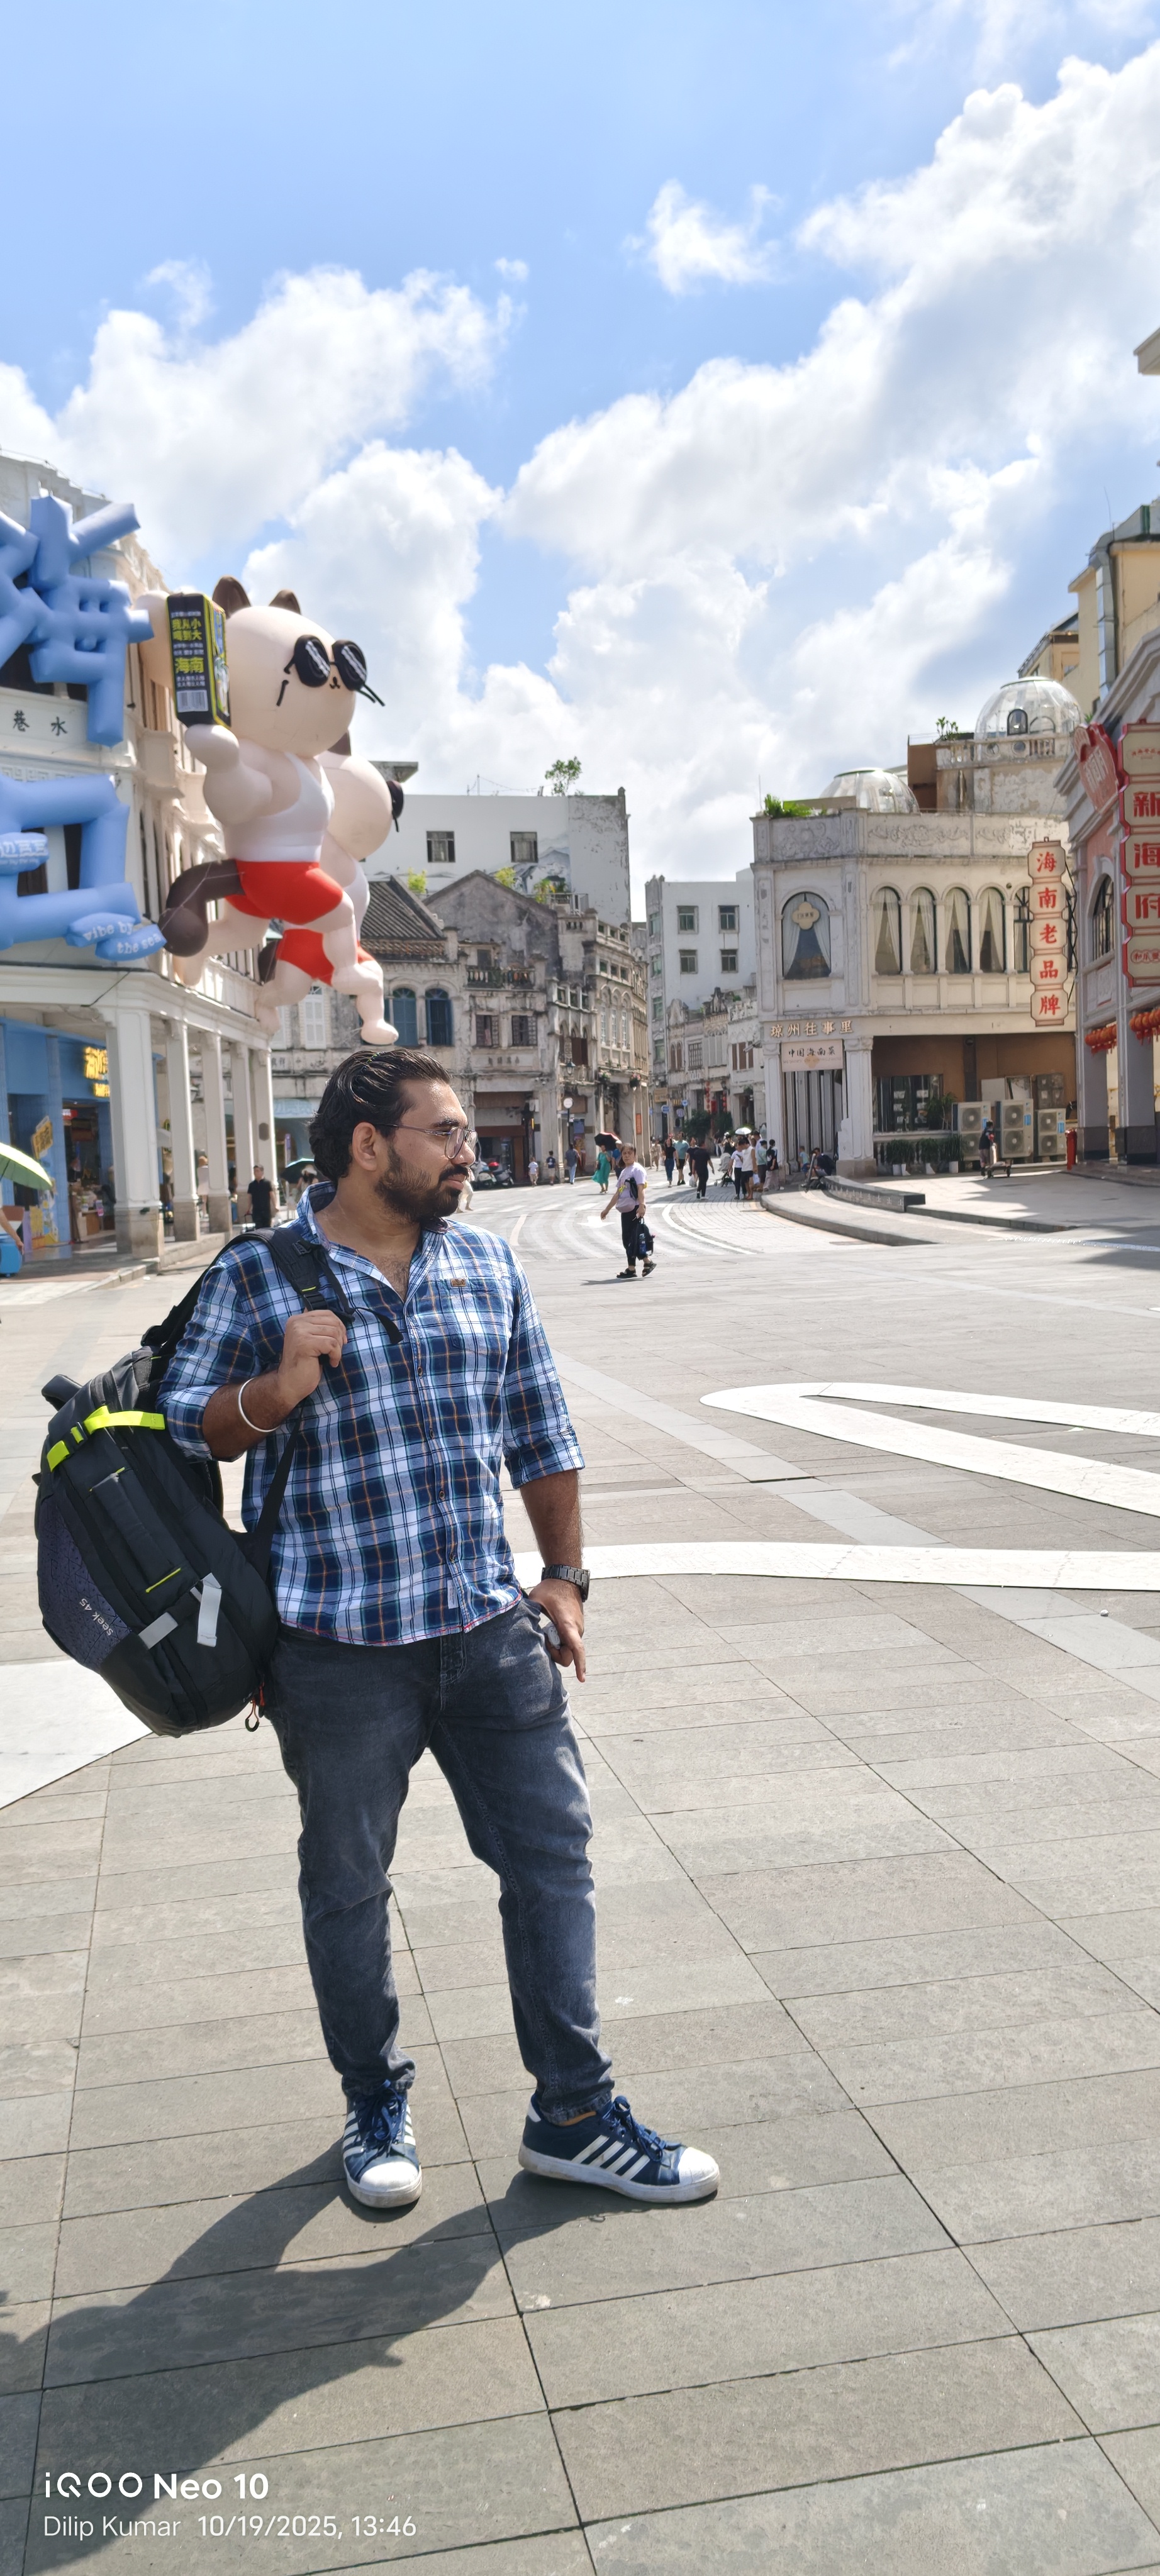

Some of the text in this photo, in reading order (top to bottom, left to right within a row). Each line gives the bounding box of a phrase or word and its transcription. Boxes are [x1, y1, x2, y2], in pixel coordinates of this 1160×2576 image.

[83, 921, 133, 941] vibe by
[1036, 851, 1061, 1016] 海南老品牌
[116, 933, 162, 955] the sea
[770, 1020, 853, 1038] 琼州往事里
[79, 1598, 114, 1636] seek 45
